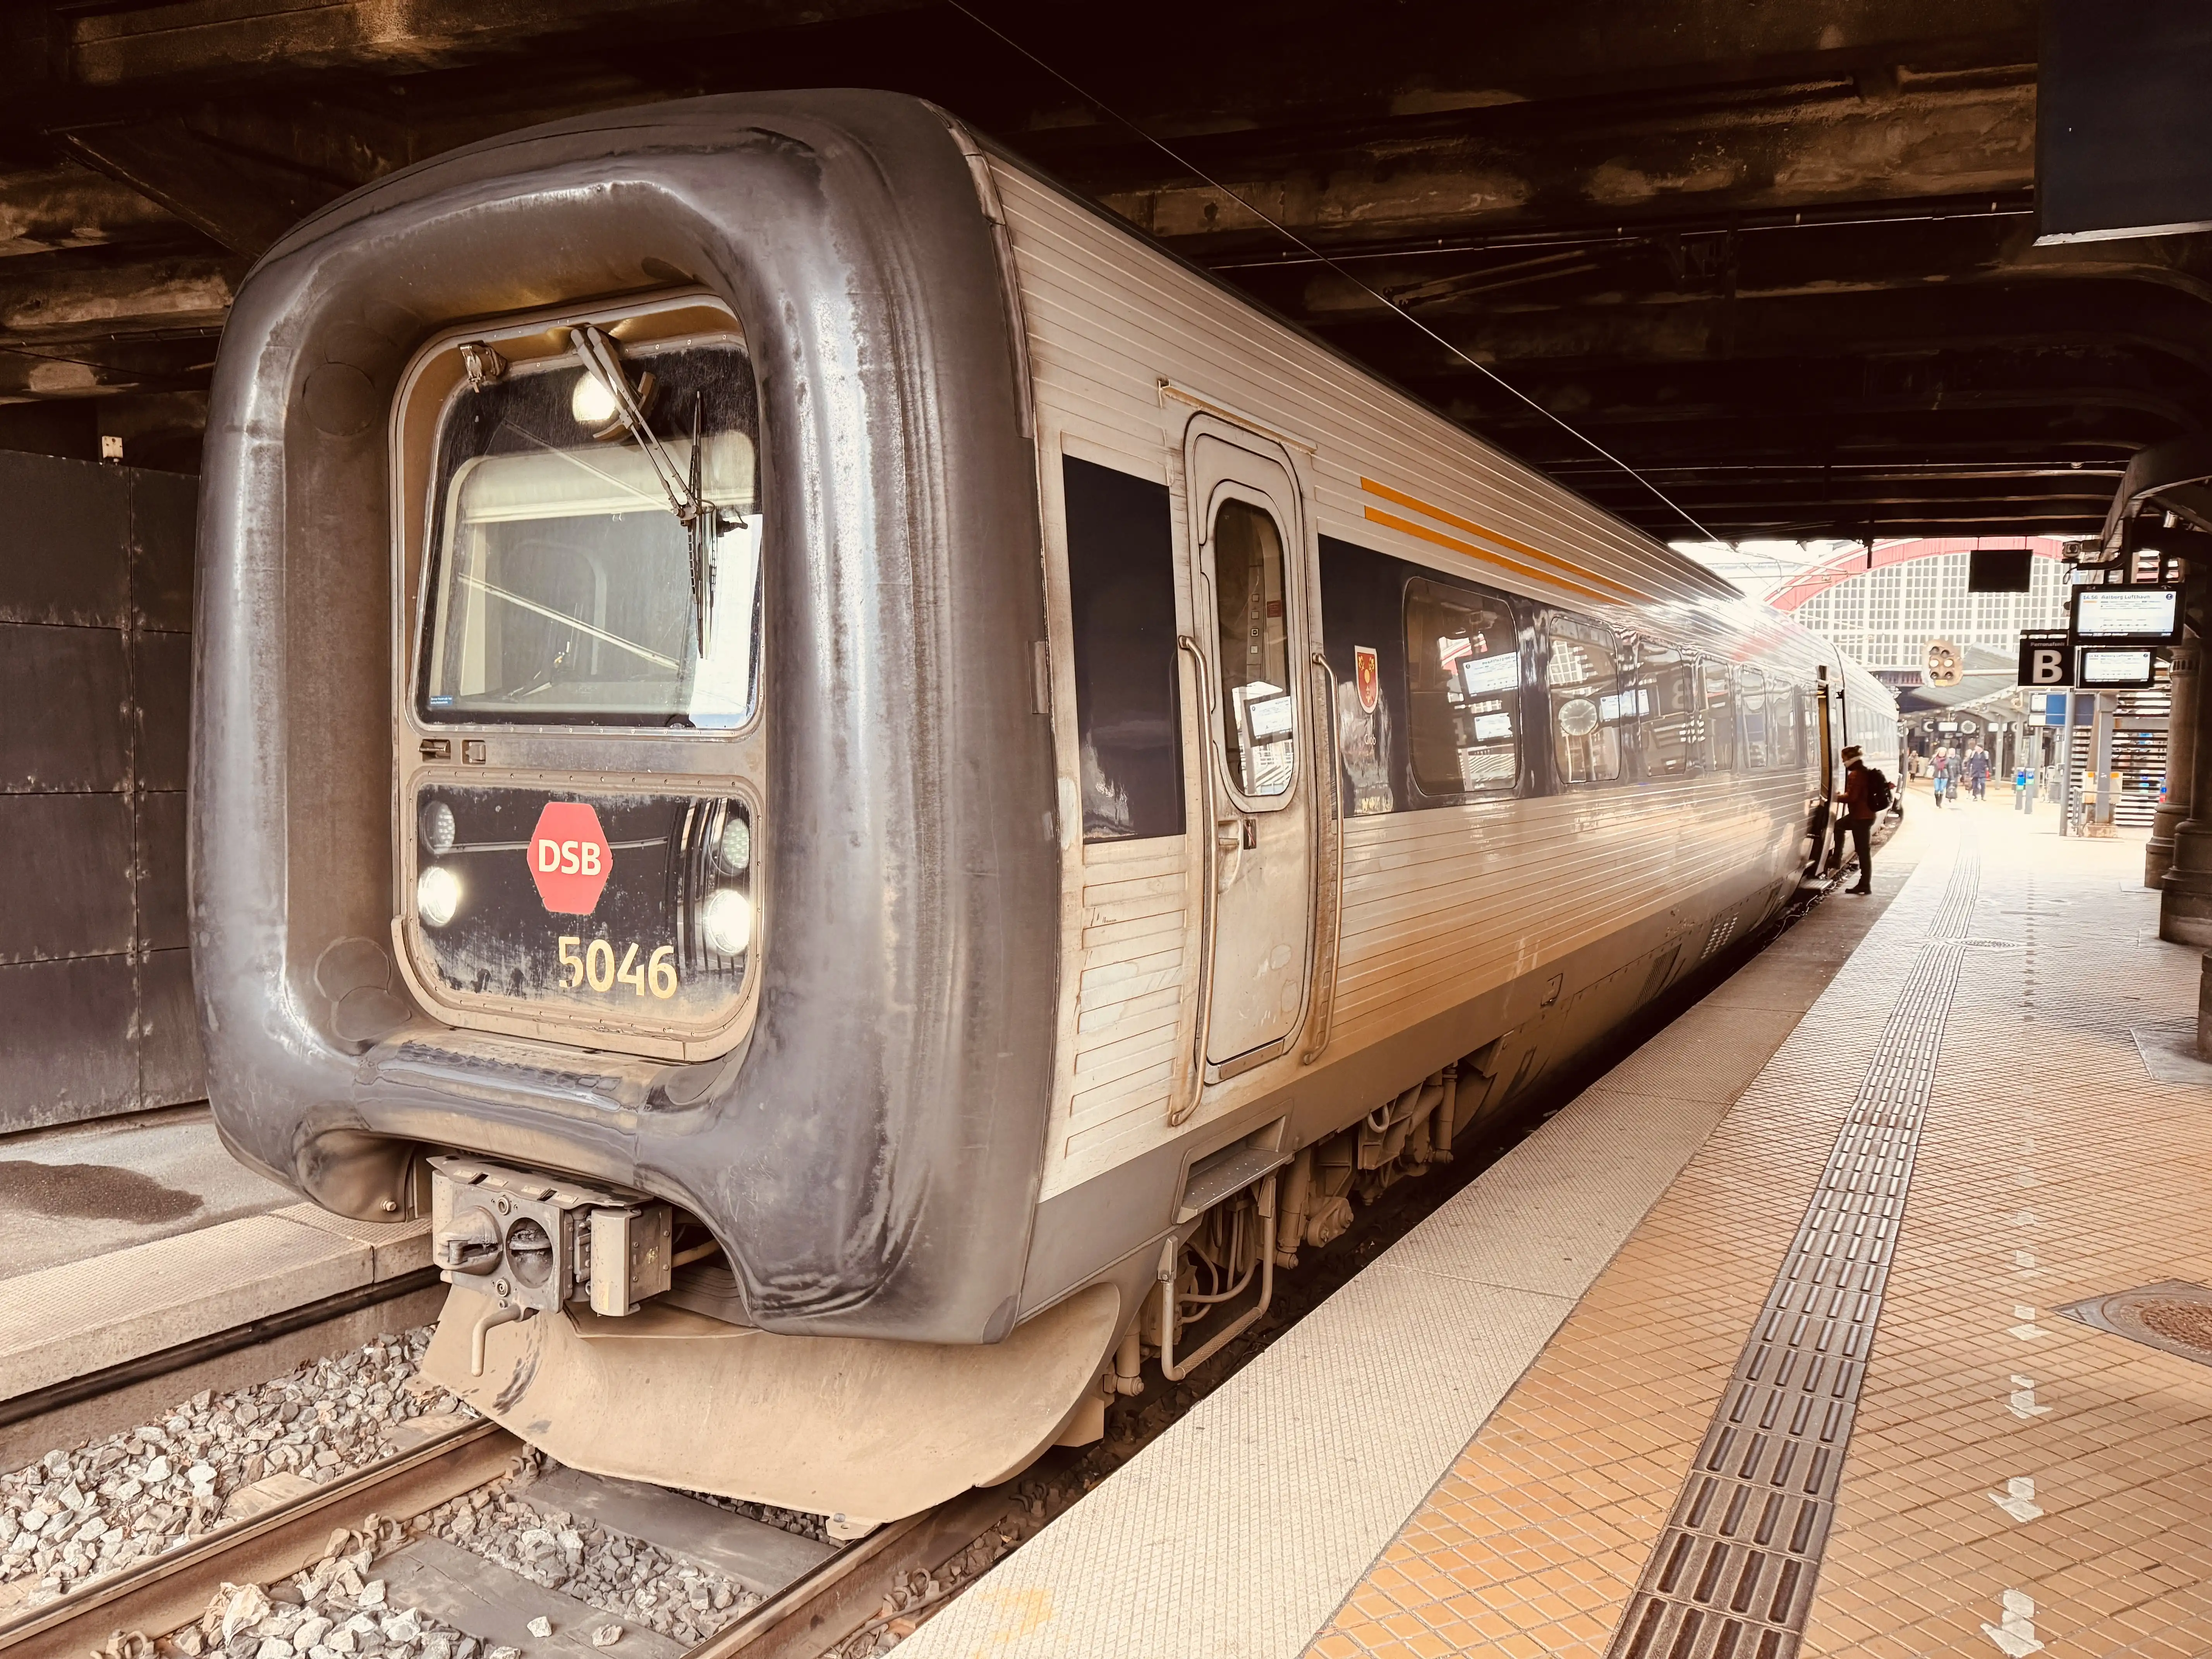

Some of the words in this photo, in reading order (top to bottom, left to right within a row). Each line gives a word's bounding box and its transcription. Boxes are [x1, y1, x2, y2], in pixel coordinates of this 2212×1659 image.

[2033, 650, 2063, 683] B
[1364, 734, 1376, 745] Glob
[538, 839, 601, 875] DSB
[558, 936, 678, 999] 5046
